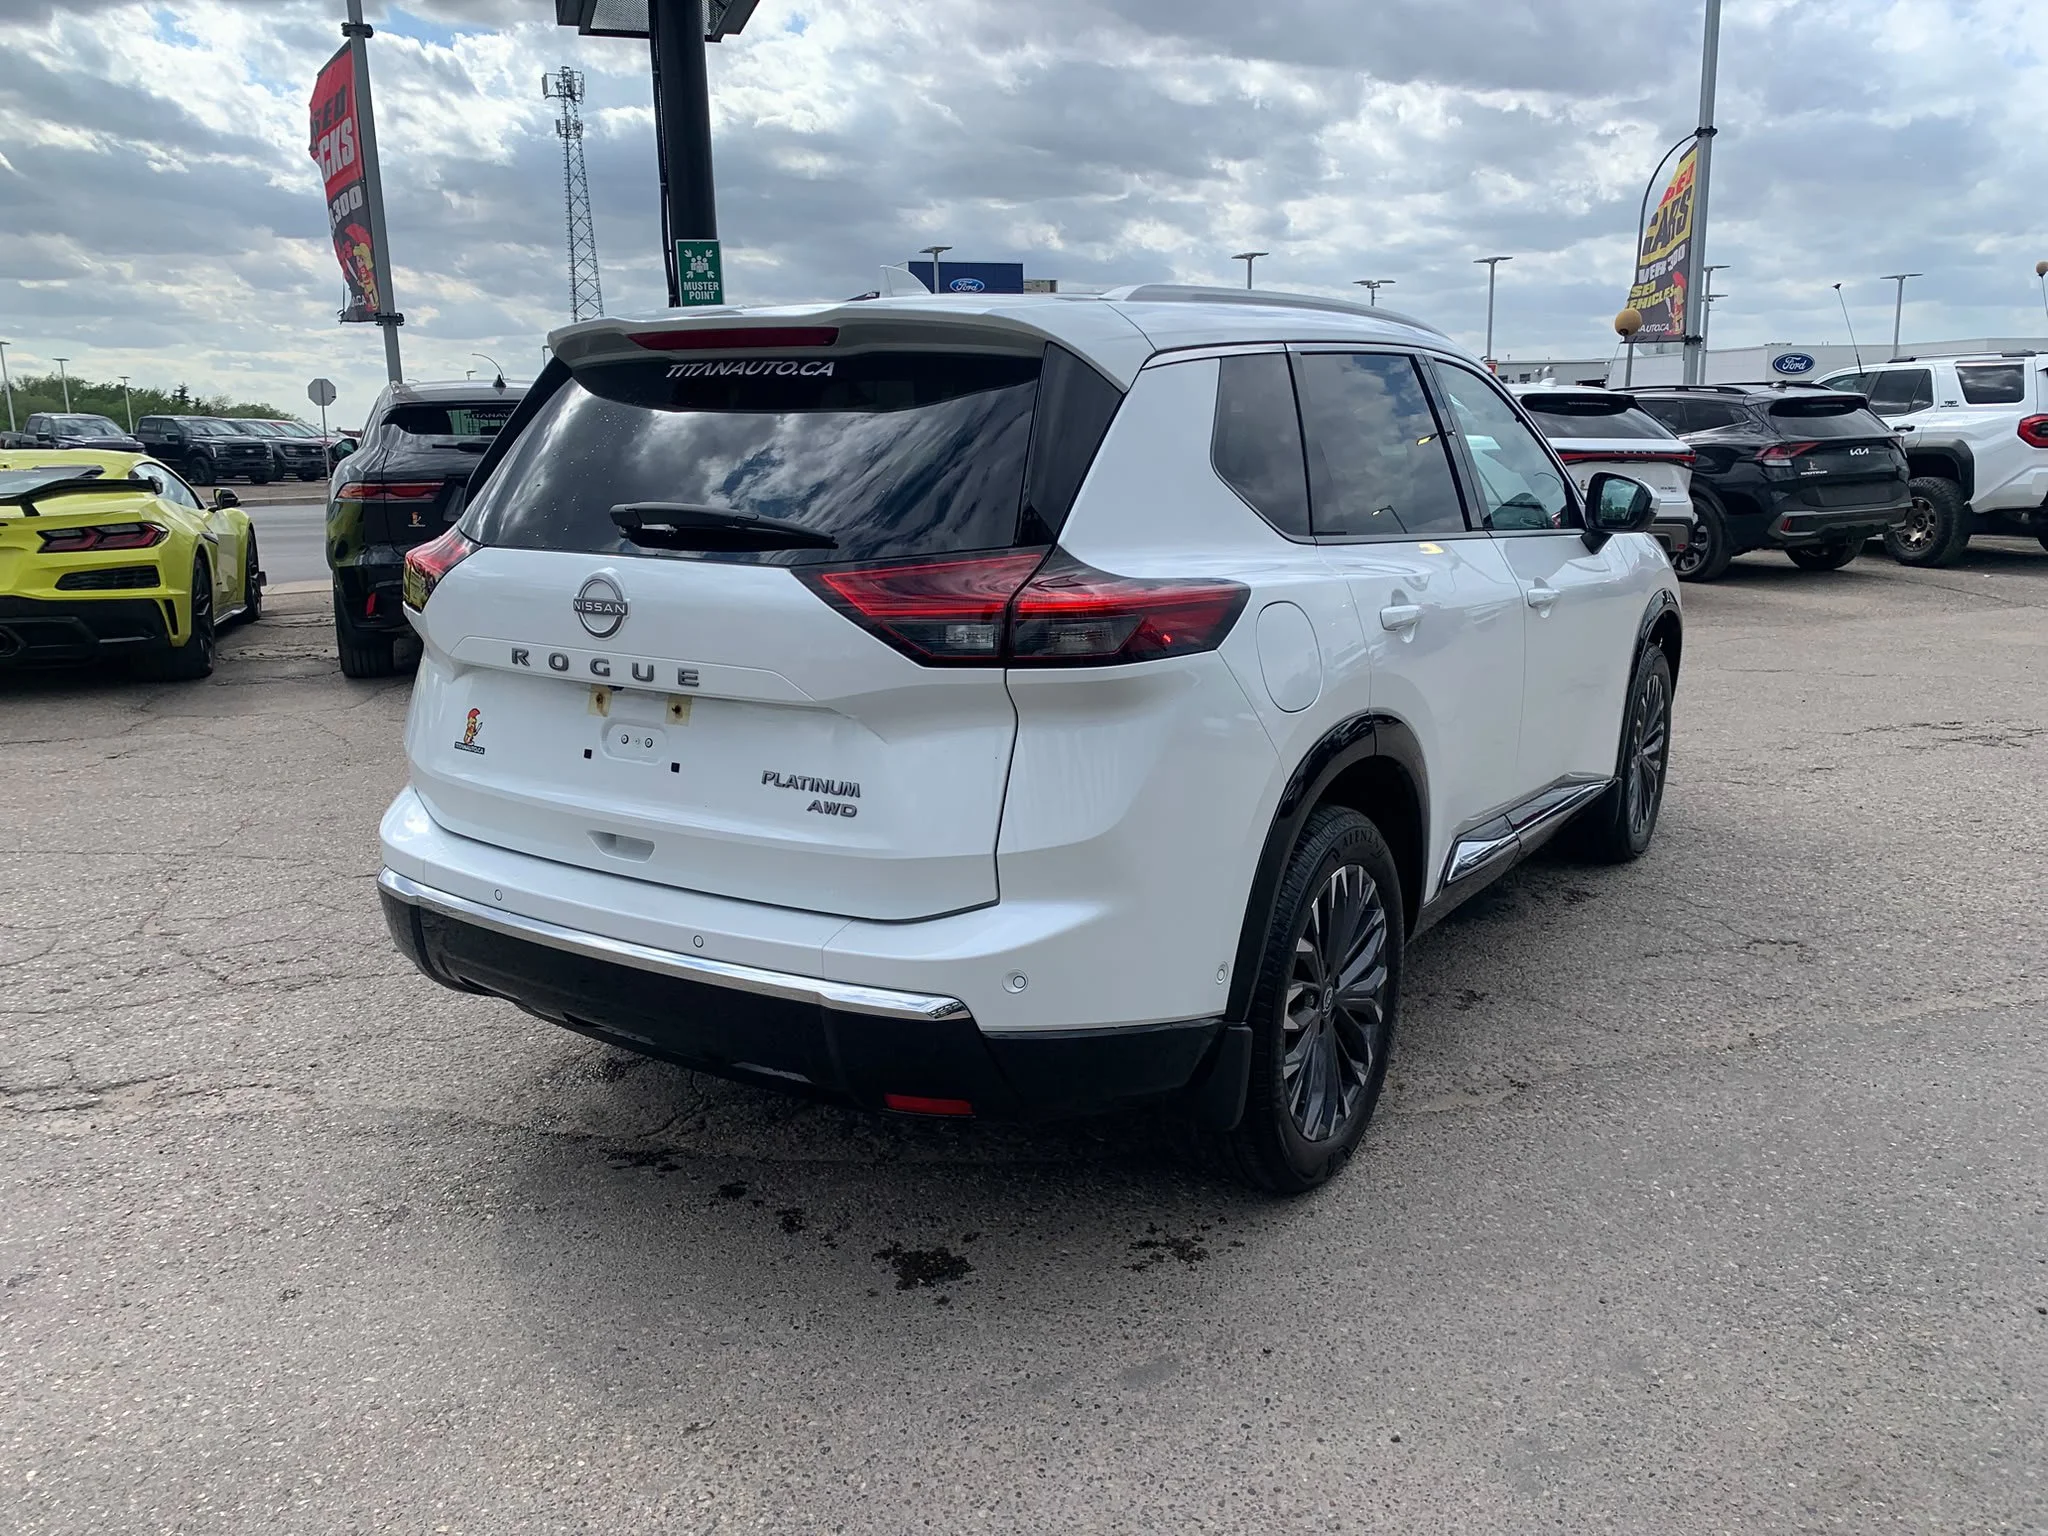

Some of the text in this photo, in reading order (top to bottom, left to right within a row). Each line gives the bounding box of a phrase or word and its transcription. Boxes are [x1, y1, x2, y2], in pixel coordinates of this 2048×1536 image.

[314, 117, 355, 183] CKS
[683, 281, 719, 291] MUSTER
[955, 280, 978, 291] Ford
[689, 291, 715, 300] POINT
[666, 361, 835, 377] TITANAUTO.CA
[1782, 356, 1808, 370] Ford
[572, 600, 626, 615] NISSAN
[511, 647, 700, 688] ROGUE
[761, 770, 860, 798] PLATINUM
[806, 799, 858, 818] AWD
